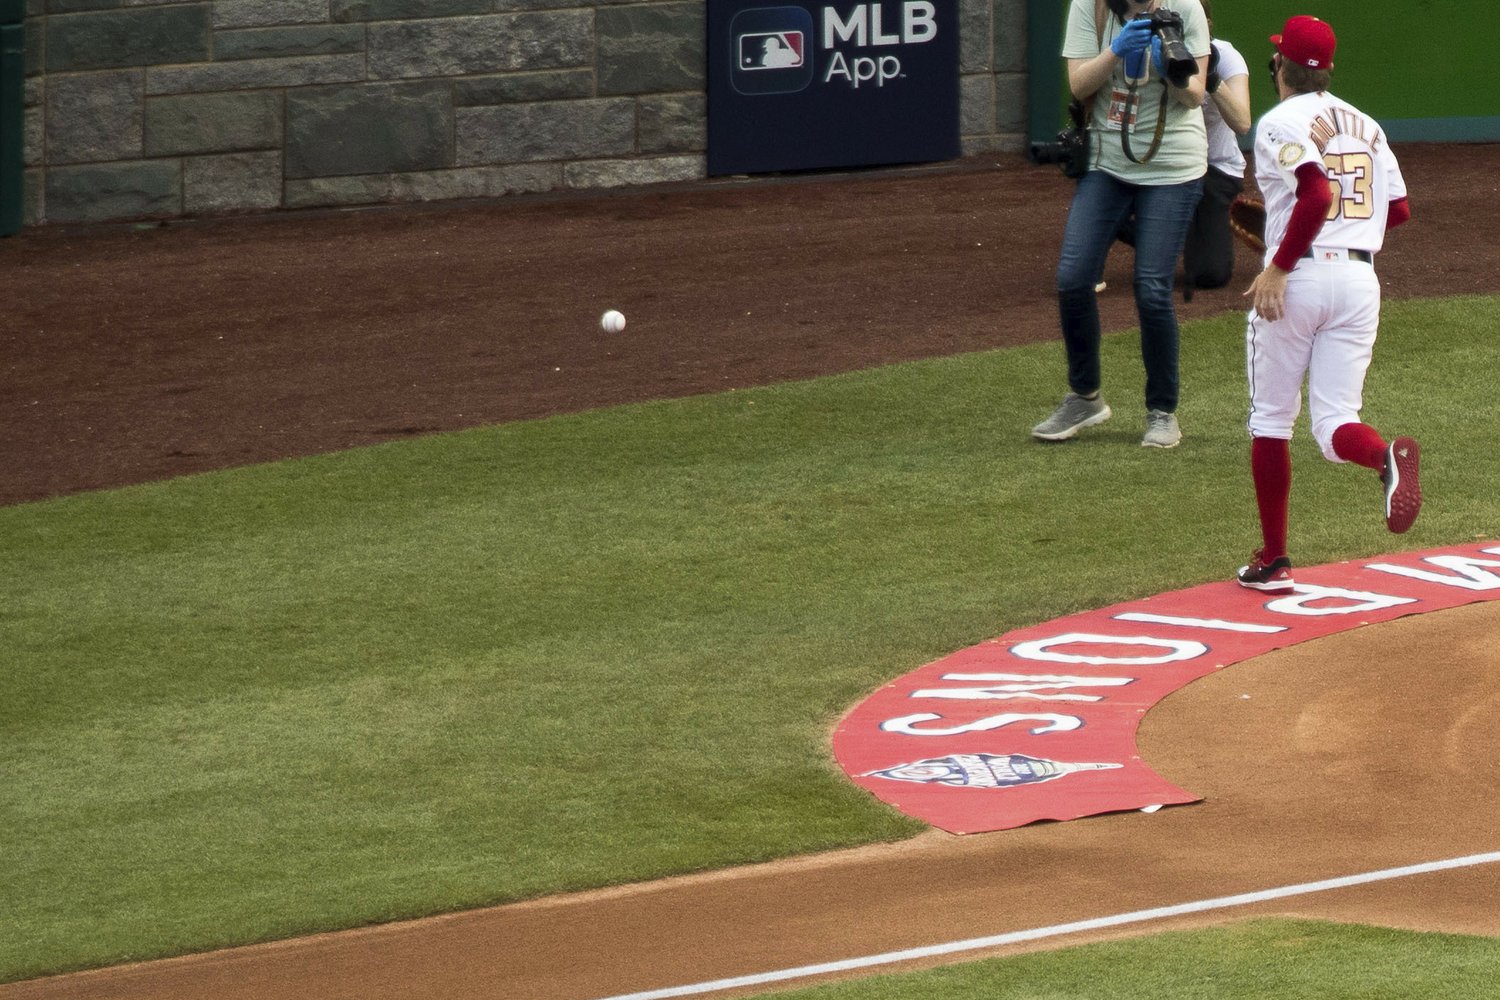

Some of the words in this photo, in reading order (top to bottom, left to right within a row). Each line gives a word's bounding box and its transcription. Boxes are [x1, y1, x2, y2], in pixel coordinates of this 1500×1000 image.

[824, 1, 938, 49] MLB
[825, 51, 901, 89] App
[1322, 151, 1374, 221] 63
